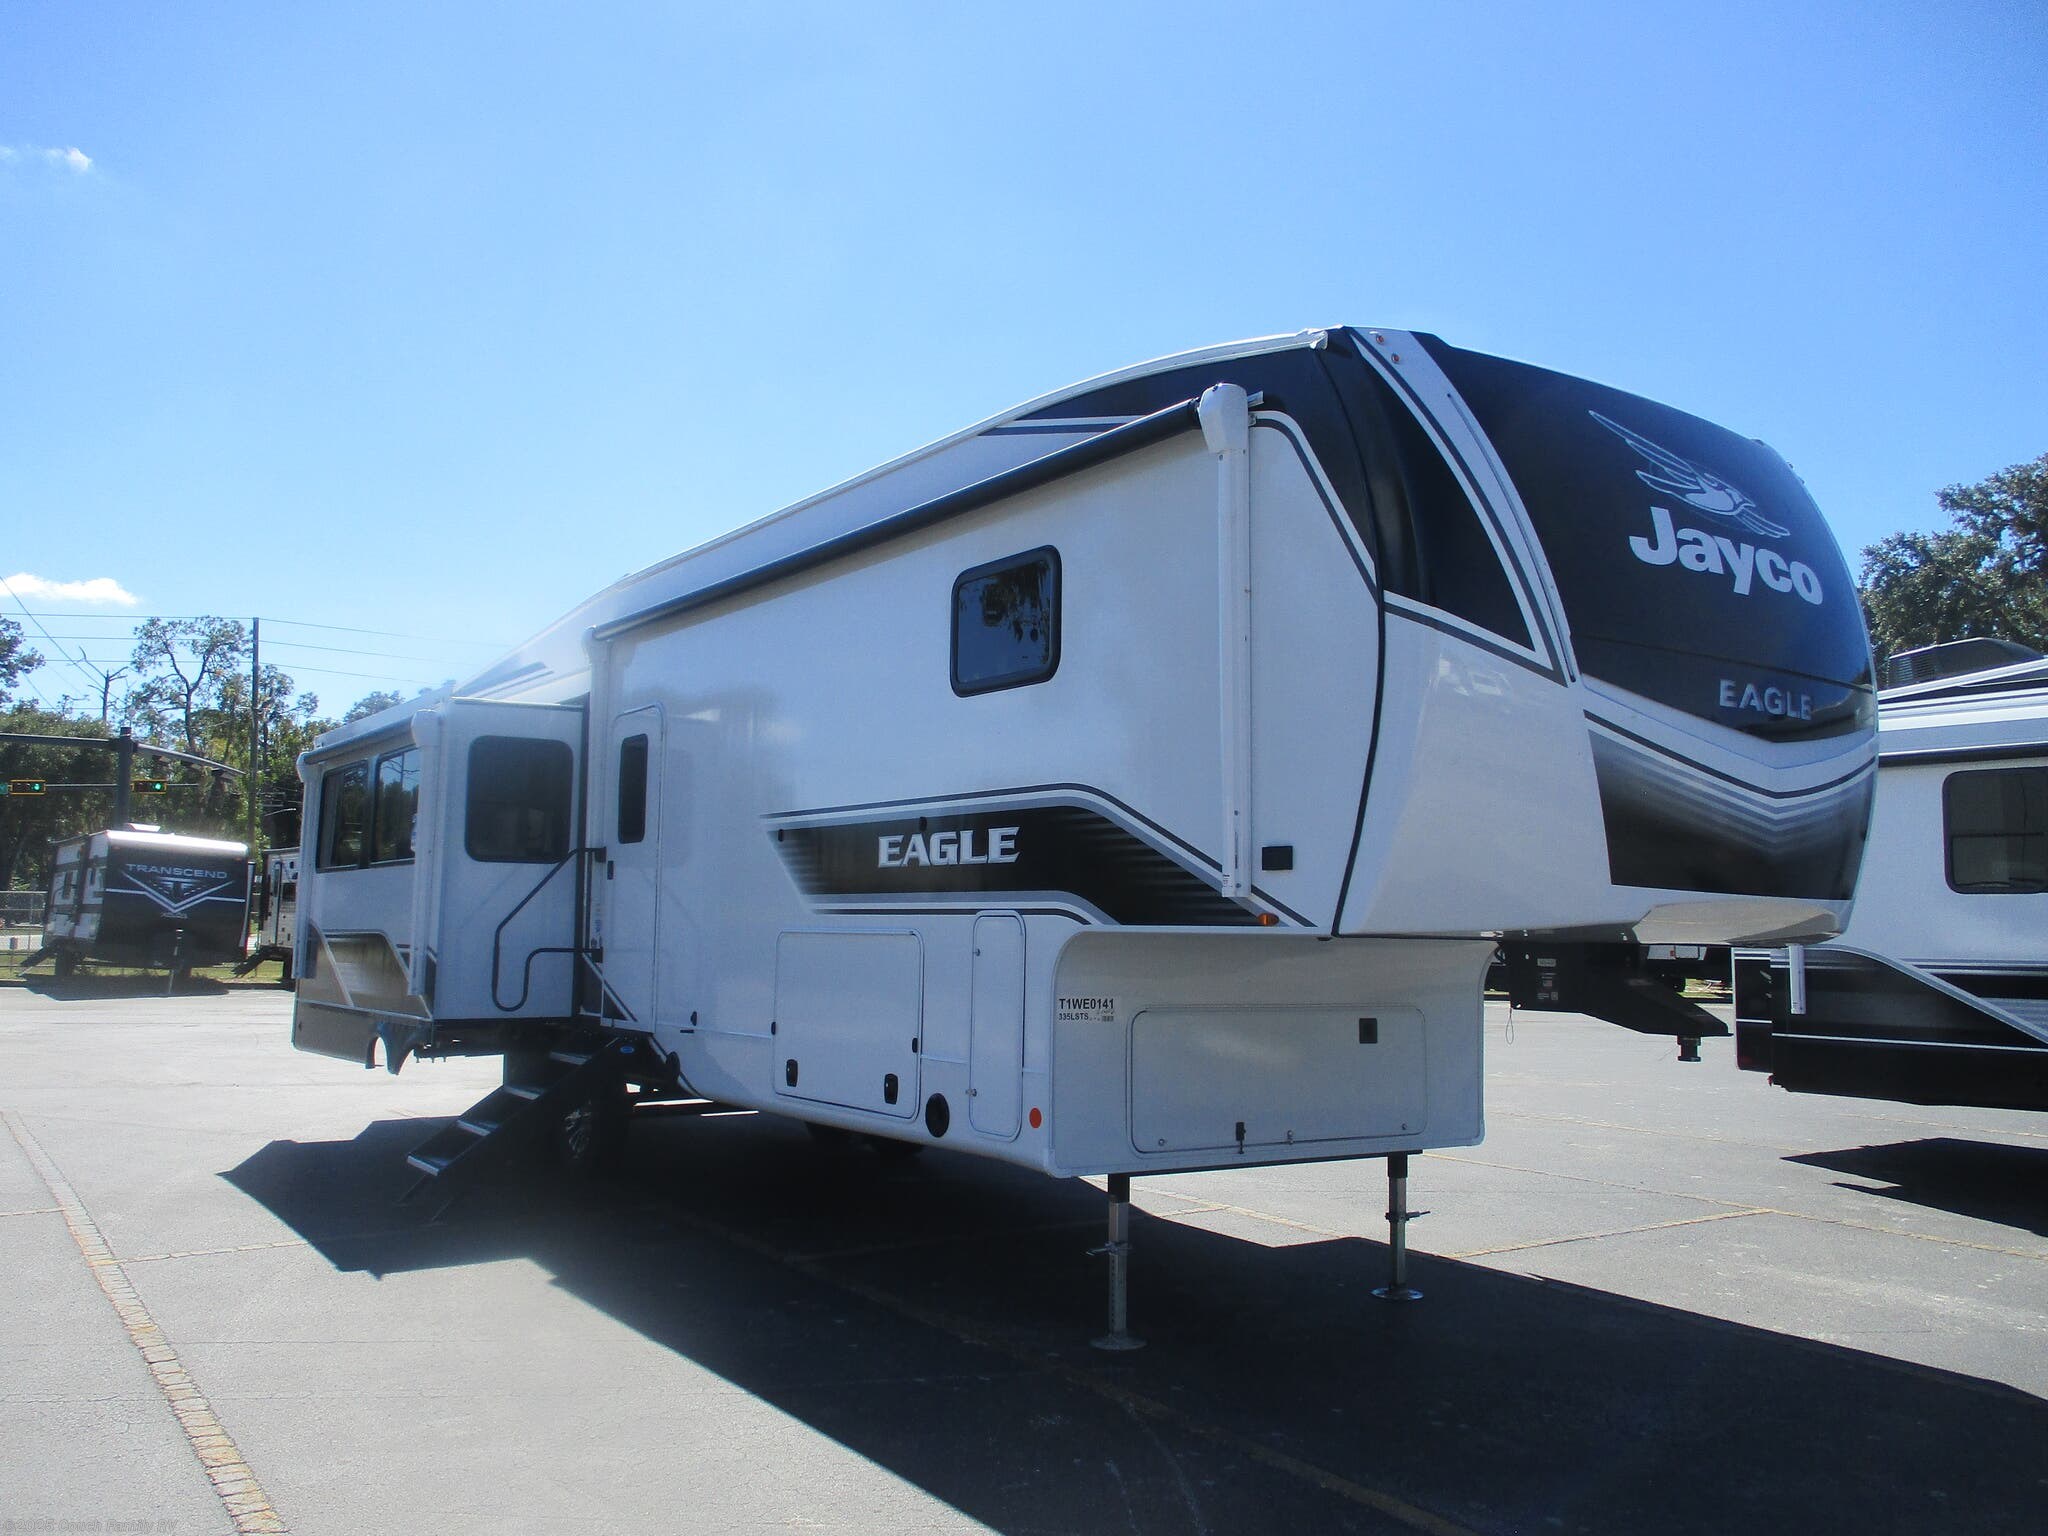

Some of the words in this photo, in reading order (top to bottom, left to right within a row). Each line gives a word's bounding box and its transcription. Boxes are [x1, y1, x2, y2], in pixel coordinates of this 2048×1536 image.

[1628, 506, 1824, 606] Jayco
[1719, 678, 1812, 721] EAGLE
[878, 826, 1021, 868] EAGLE
[125, 863, 228, 879] TRANSCEND
[1058, 998, 1114, 1010] T1WE0141
[1058, 1012, 1089, 1021] 335LSTS
